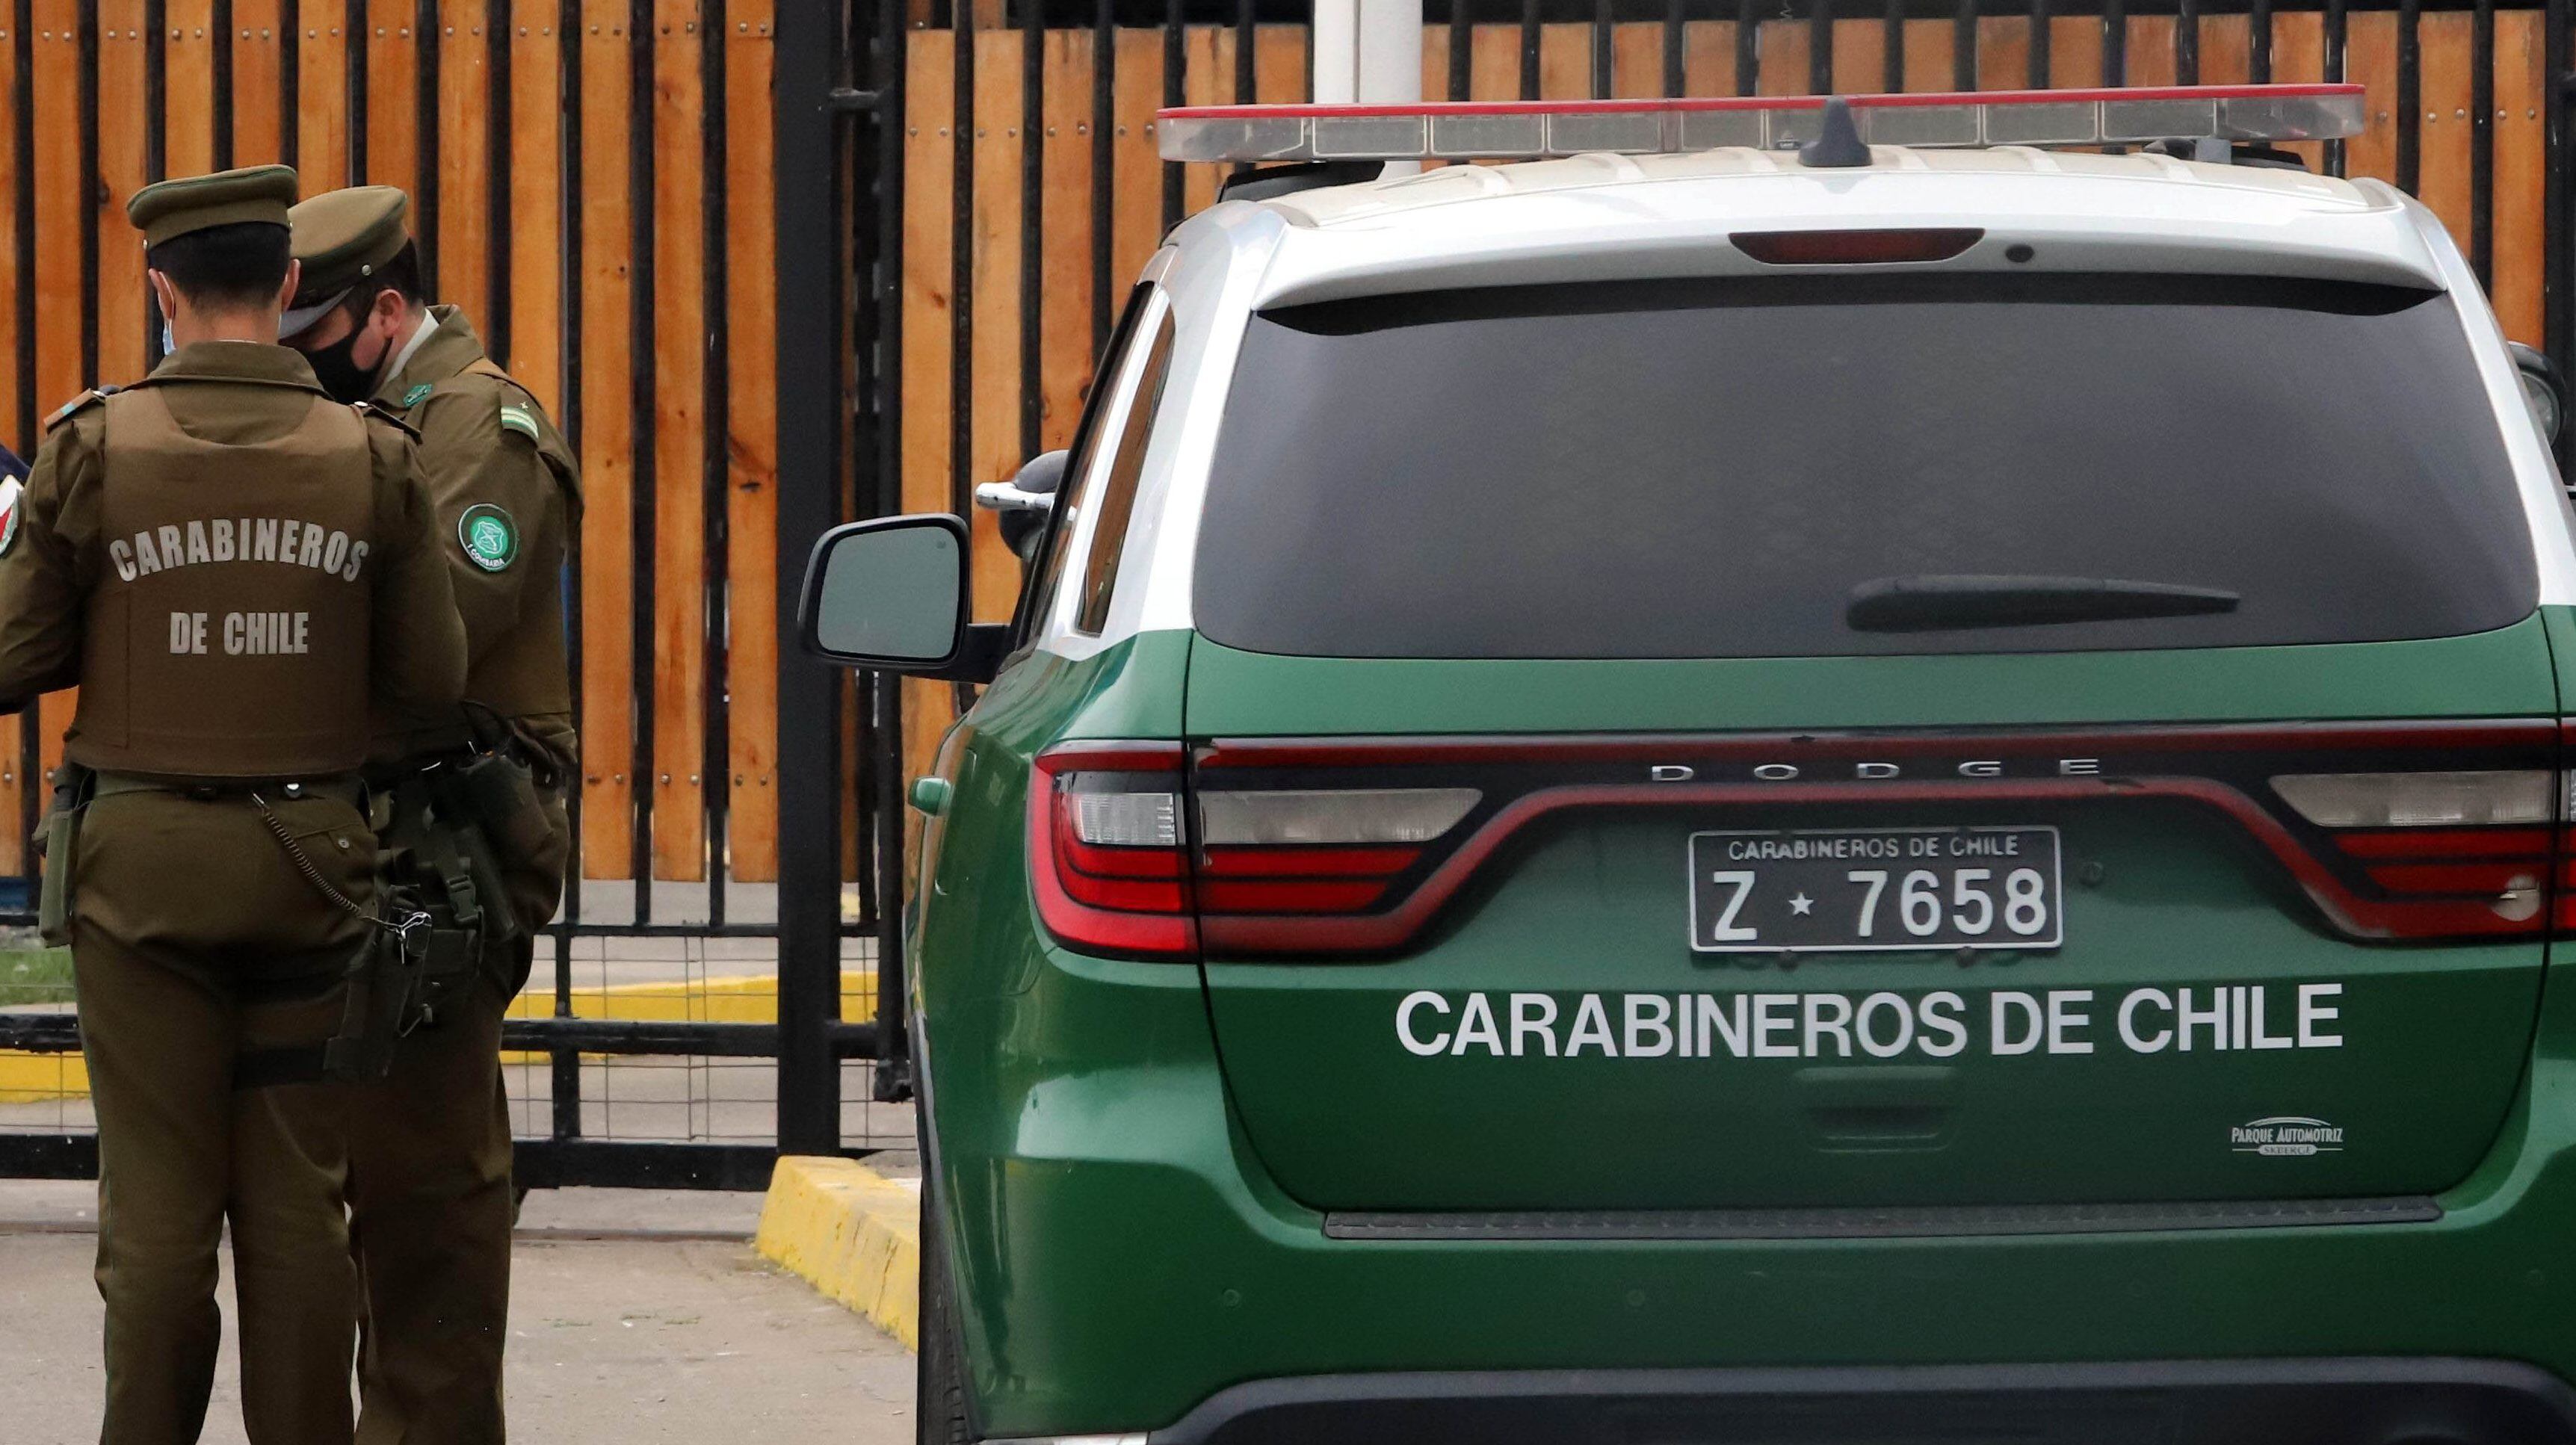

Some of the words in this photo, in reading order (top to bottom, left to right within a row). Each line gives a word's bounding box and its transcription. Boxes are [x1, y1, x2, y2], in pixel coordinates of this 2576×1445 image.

[110, 518, 368, 582] CARABINEROS
[170, 611, 208, 655] DE
[223, 612, 309, 655] CHILE
[1651, 758, 2099, 781] DODGE
[1728, 838, 1899, 861] CARABINEROS
[1909, 837, 1939, 857] DE
[1950, 835, 2019, 857] CHILE
[1713, 870, 1758, 941] Z
[1848, 867, 2047, 937] 7658
[1395, 991, 1968, 1057] CARABINEROS
[1991, 990, 2094, 1055] DE
[2117, 983, 2343, 1053] CHILE
[2231, 1127, 2274, 1144] PARQUE
[2276, 1127, 2344, 1143] AUTOMOTRIZ
